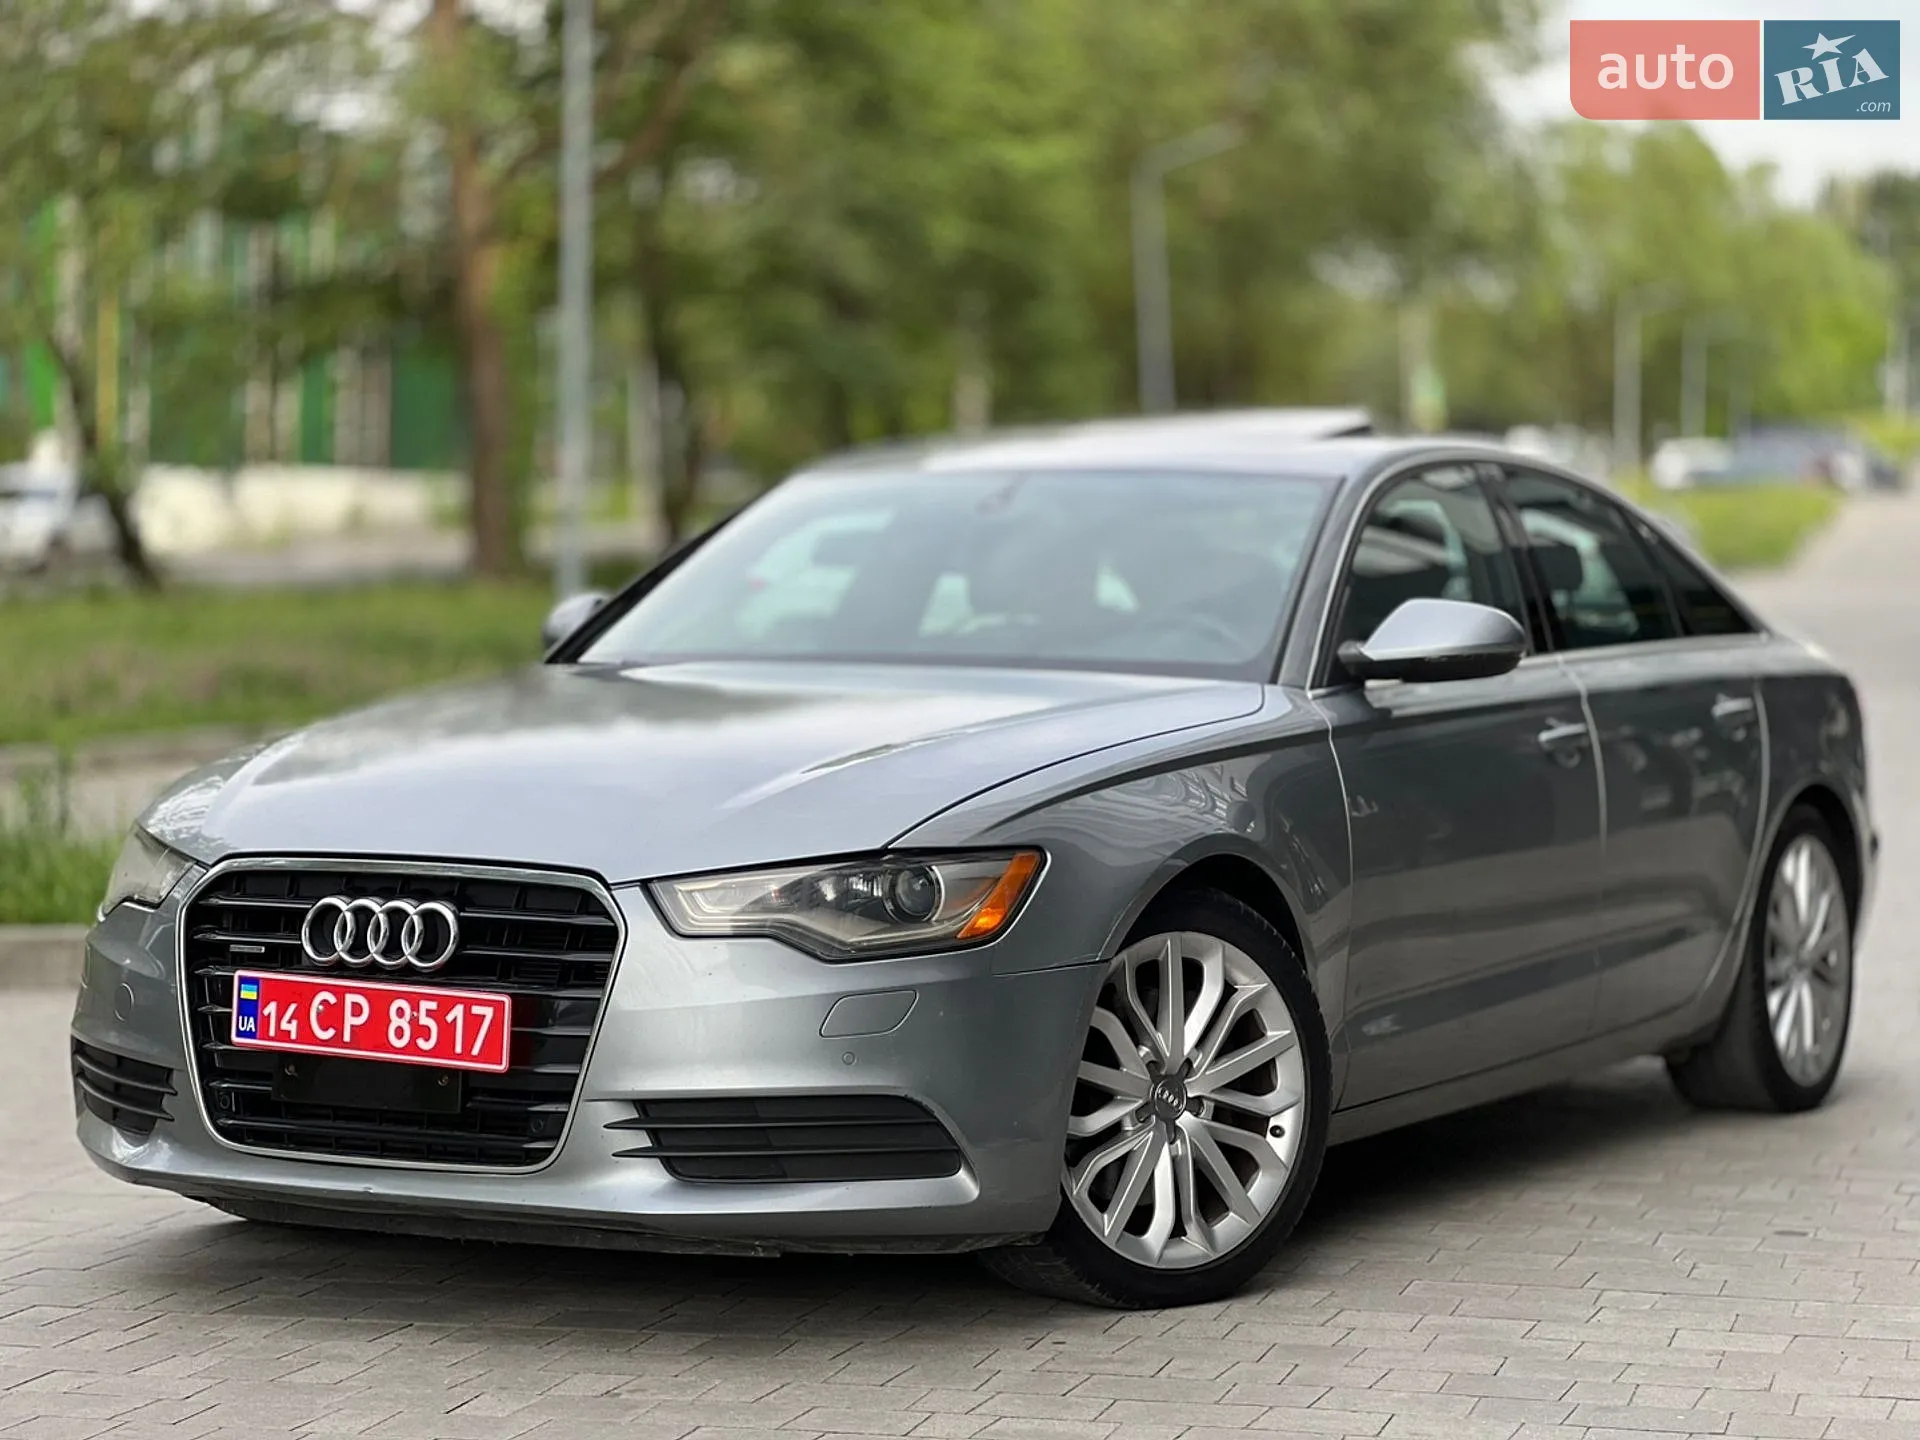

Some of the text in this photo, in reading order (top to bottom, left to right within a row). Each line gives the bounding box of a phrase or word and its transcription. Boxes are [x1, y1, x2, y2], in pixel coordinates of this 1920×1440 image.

[238, 1015, 256, 1032] UA
[262, 991, 494, 1055] 14 CP 8517
